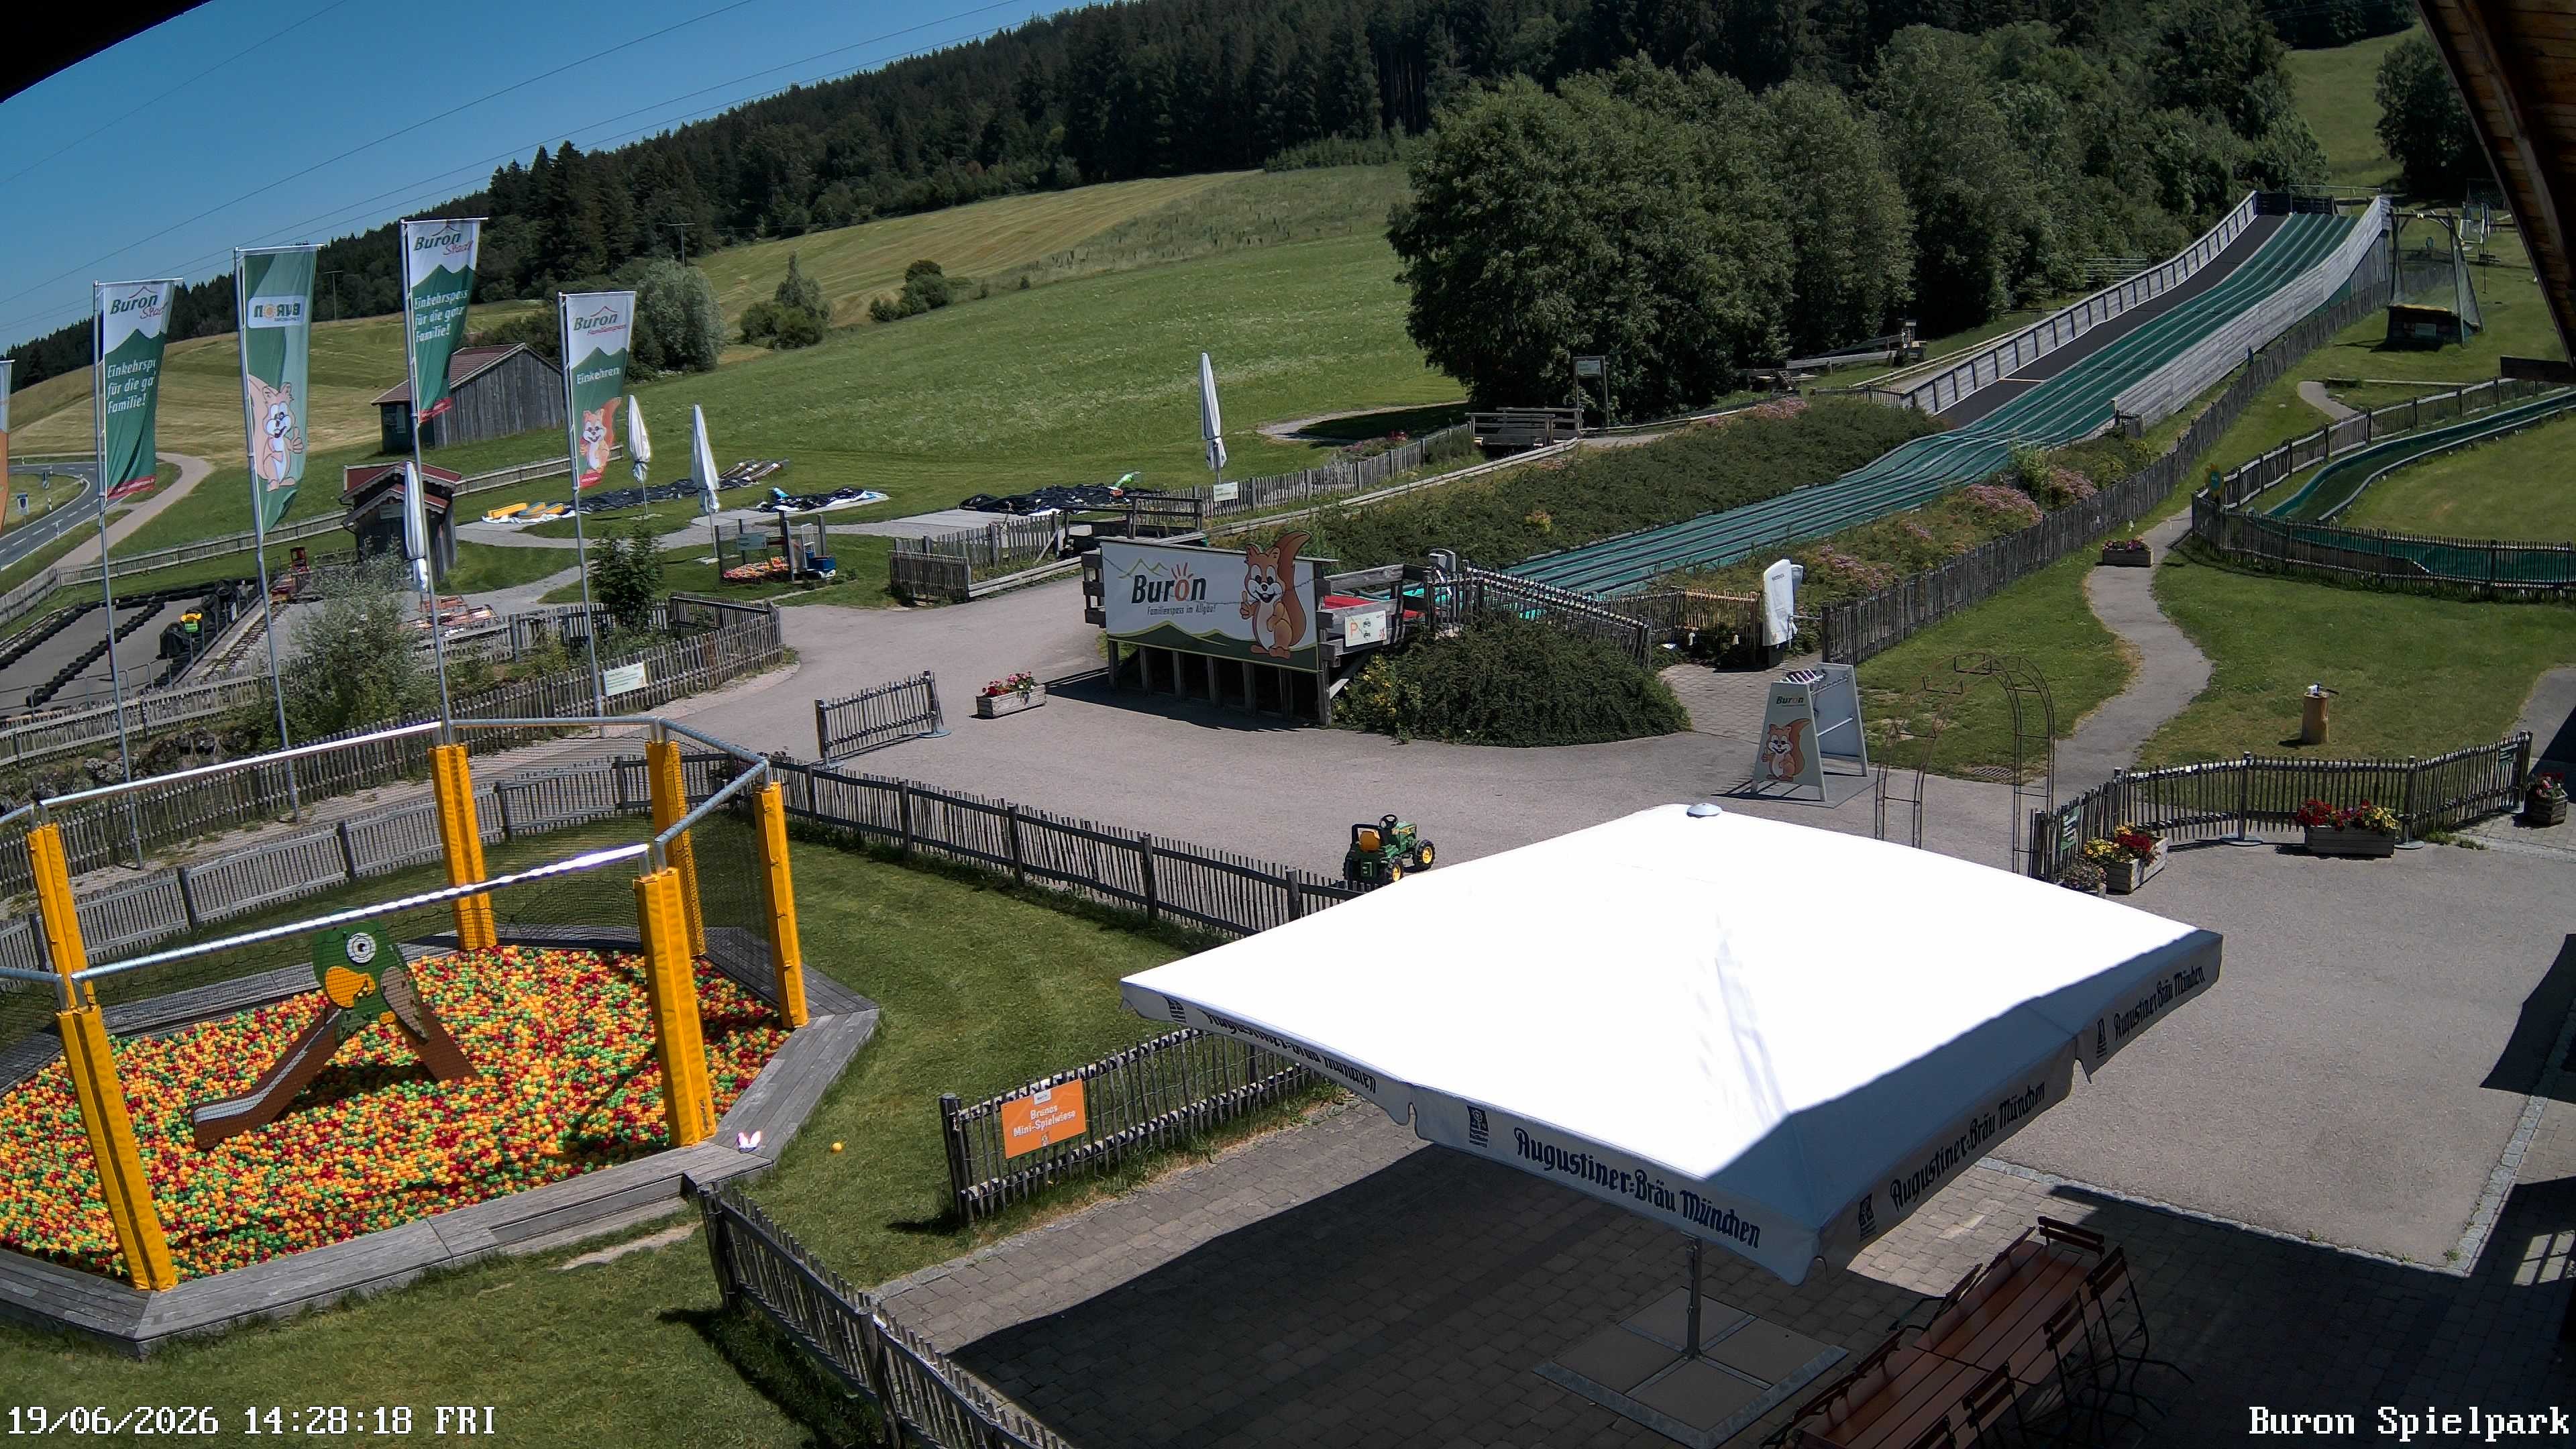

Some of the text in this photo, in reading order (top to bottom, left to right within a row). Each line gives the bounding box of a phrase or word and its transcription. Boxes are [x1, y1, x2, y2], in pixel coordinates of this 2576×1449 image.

[413, 233, 462, 252] Buron
[110, 295, 158, 315] Buron
[574, 313, 619, 331] Buron
[577, 367, 621, 384] Einkehren
[107, 382, 122, 400] für
[124, 378, 140, 392] die
[107, 392, 146, 414] Familie!
[1131, 574, 1207, 604] Buron
[1776, 696, 1804, 704] Buron
[1998, 1081, 2045, 1130] München
[1679, 1189, 1762, 1249] München
